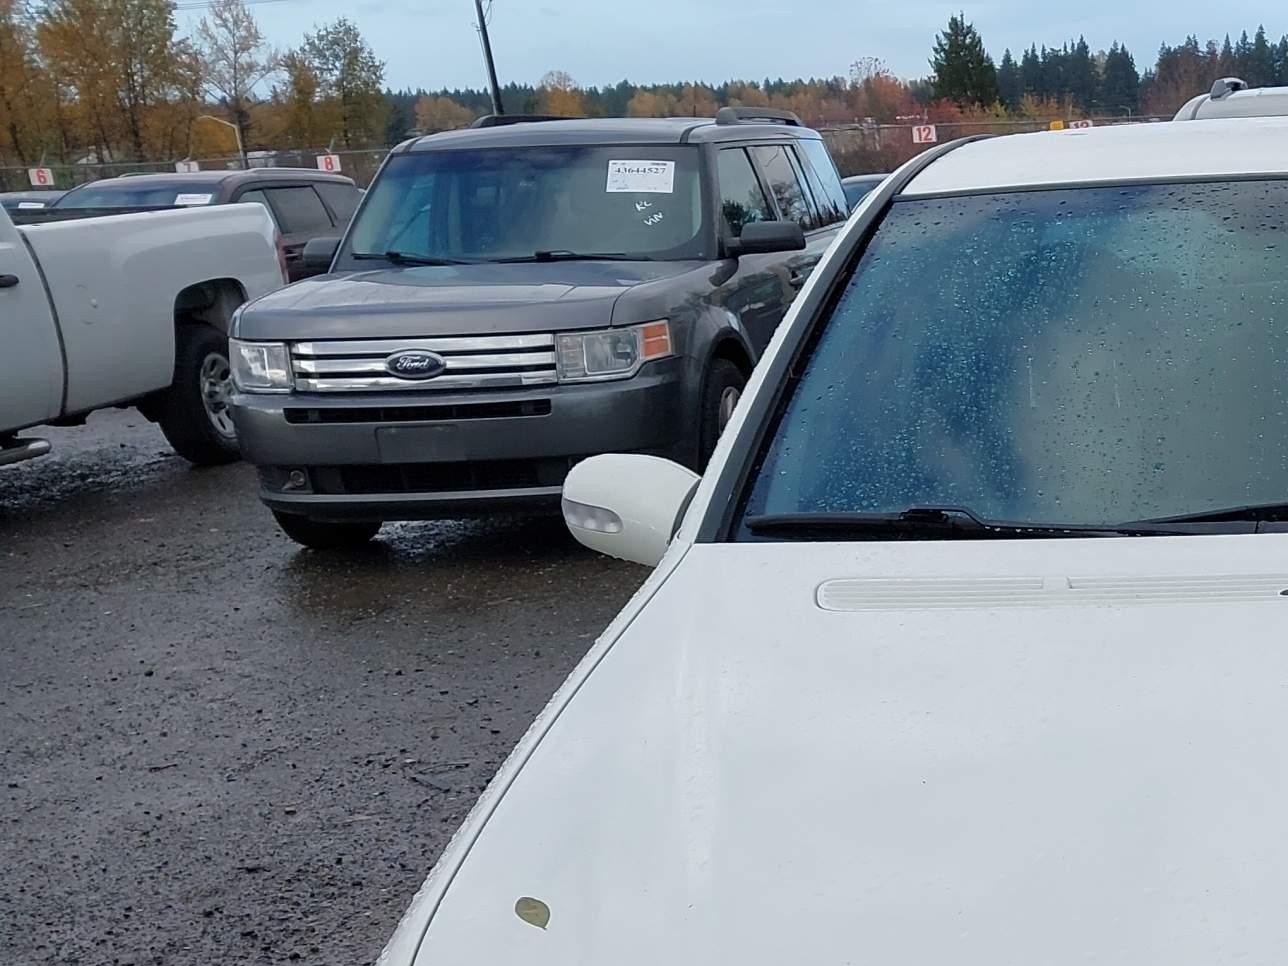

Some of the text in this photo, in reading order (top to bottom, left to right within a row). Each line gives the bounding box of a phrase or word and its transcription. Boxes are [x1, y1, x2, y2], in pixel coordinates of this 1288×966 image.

[915, 126, 932, 142] 12
[323, 156, 334, 171] 8
[36, 170, 47, 184] 6
[396, 356, 429, 370] Ford
